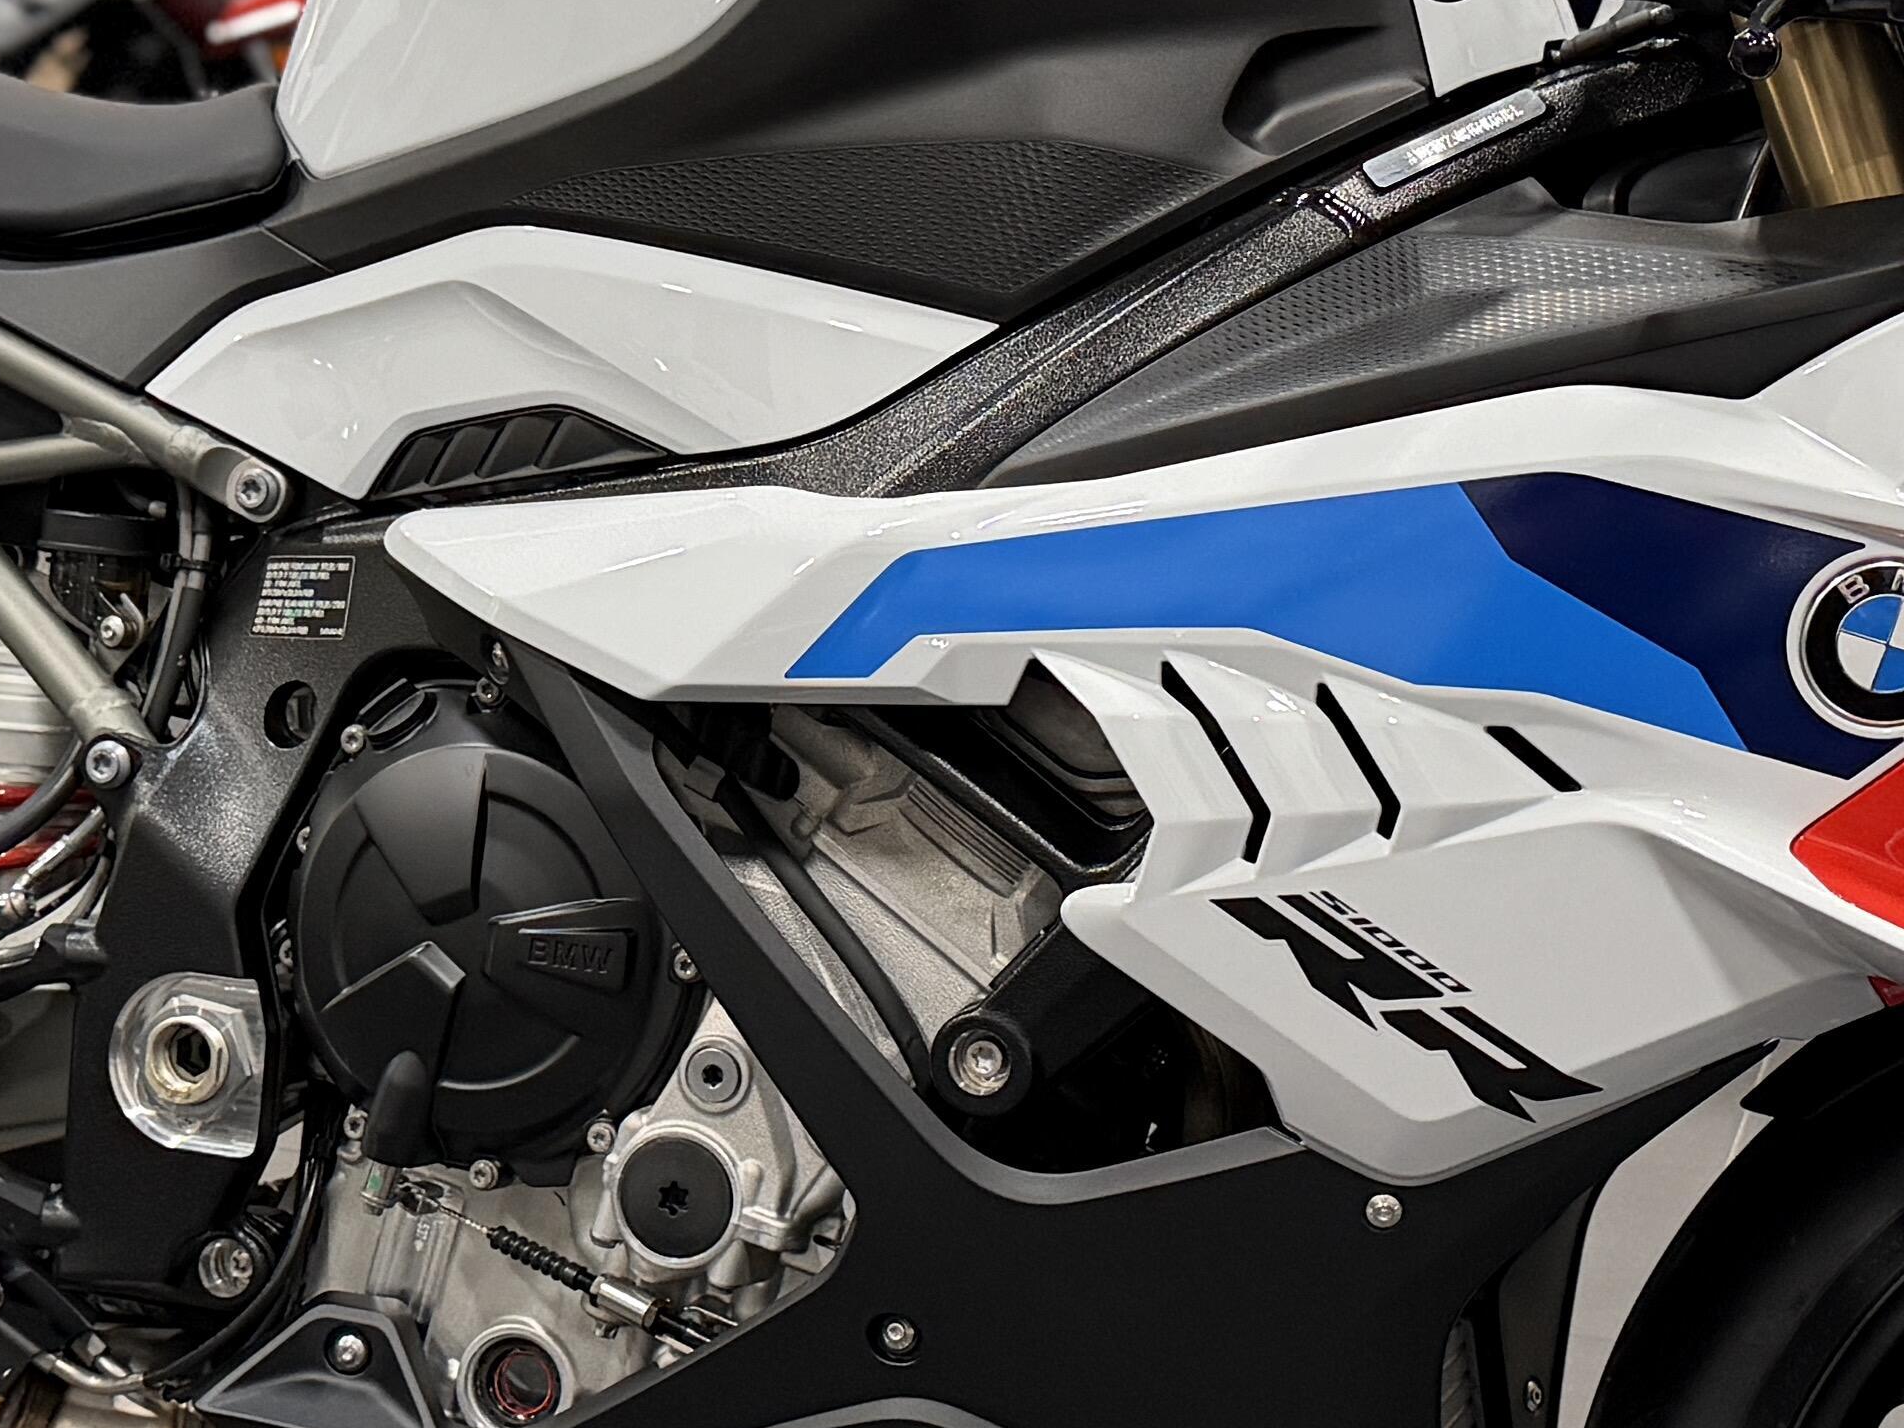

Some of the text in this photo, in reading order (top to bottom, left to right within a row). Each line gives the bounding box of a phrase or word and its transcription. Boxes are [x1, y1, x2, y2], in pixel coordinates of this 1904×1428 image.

[527, 937, 614, 974] BMW
[1309, 890, 1473, 993] S1000
[1209, 894, 1604, 1123] RR
